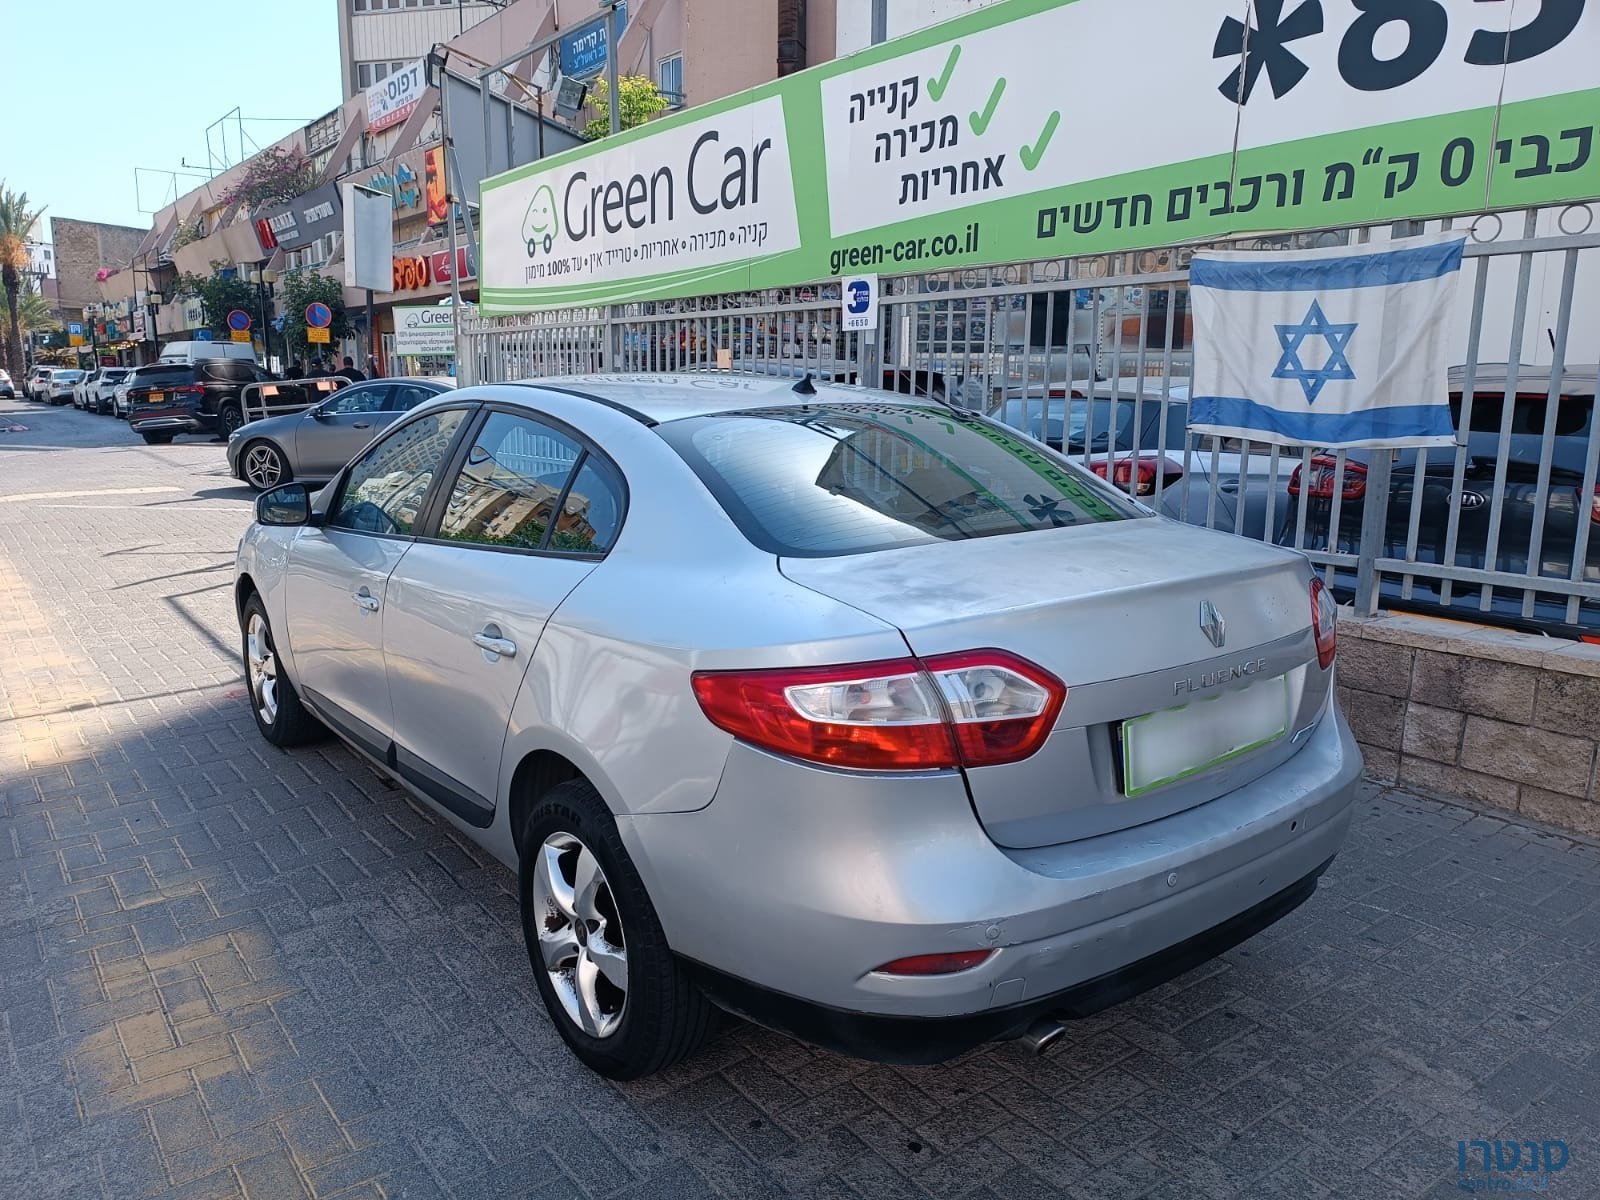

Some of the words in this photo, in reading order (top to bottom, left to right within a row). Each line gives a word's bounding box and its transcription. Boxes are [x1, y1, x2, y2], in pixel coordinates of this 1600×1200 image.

[572, 31, 597, 55] קדימה
[388, 67, 418, 100] דפוס
[849, 75, 920, 123] קנייה
[874, 114, 959, 163] מכירה
[1494, 125, 1600, 181] כבי
[898, 154, 1006, 205] אחריות
[1440, 136, 1475, 188] 0
[563, 166, 674, 242] Green
[687, 130, 771, 215] Car
[1166, 168, 1305, 222] ורכבים
[1036, 193, 1153, 239] חדשים
[641, 238, 679, 261] אחריות
[689, 230, 726, 253] מכירה
[738, 221, 768, 249] קניה
[829, 222, 979, 275] green-car.co.il
[547, 257, 571, 277] 100%
[571, 255, 582, 272] עד
[589, 251, 603, 273] אין
[605, 246, 632, 264] טרייד
[524, 264, 545, 285] מימון
[1172, 657, 1267, 697] FLUENCE
